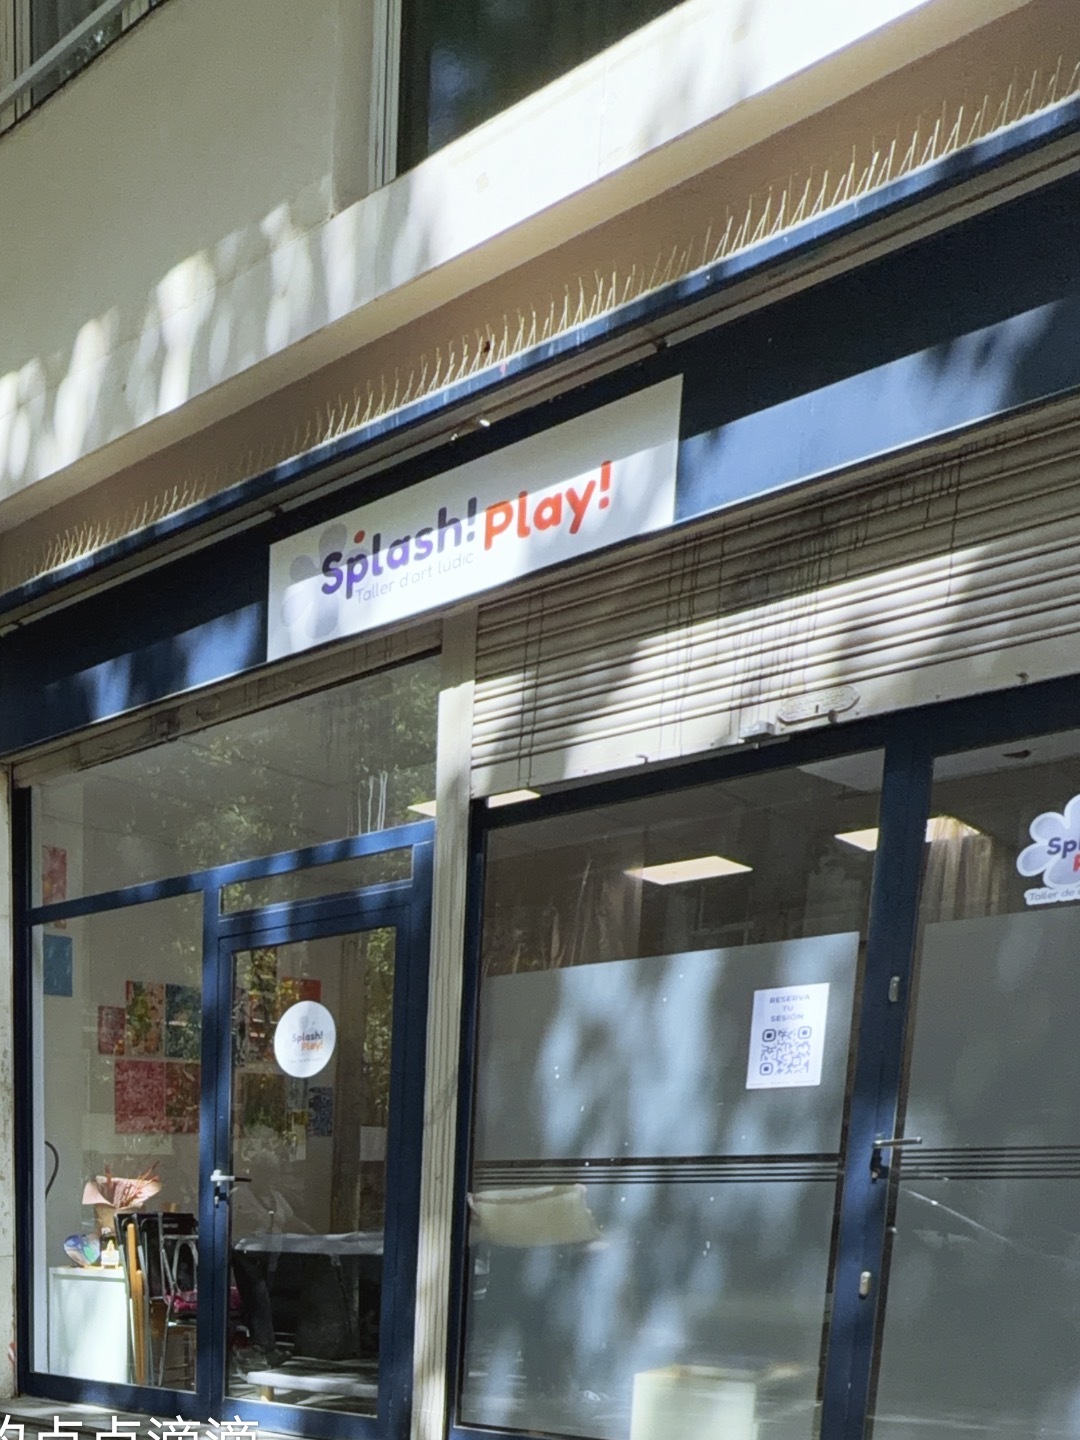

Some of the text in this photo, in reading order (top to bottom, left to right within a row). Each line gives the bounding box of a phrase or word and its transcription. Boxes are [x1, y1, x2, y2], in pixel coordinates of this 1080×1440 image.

[321, 460, 612, 600] Splash! Play!
[355, 580, 395, 603] Taller
[1046, 836, 1080, 859] Sp
[769, 994, 810, 1004] RESERVA
